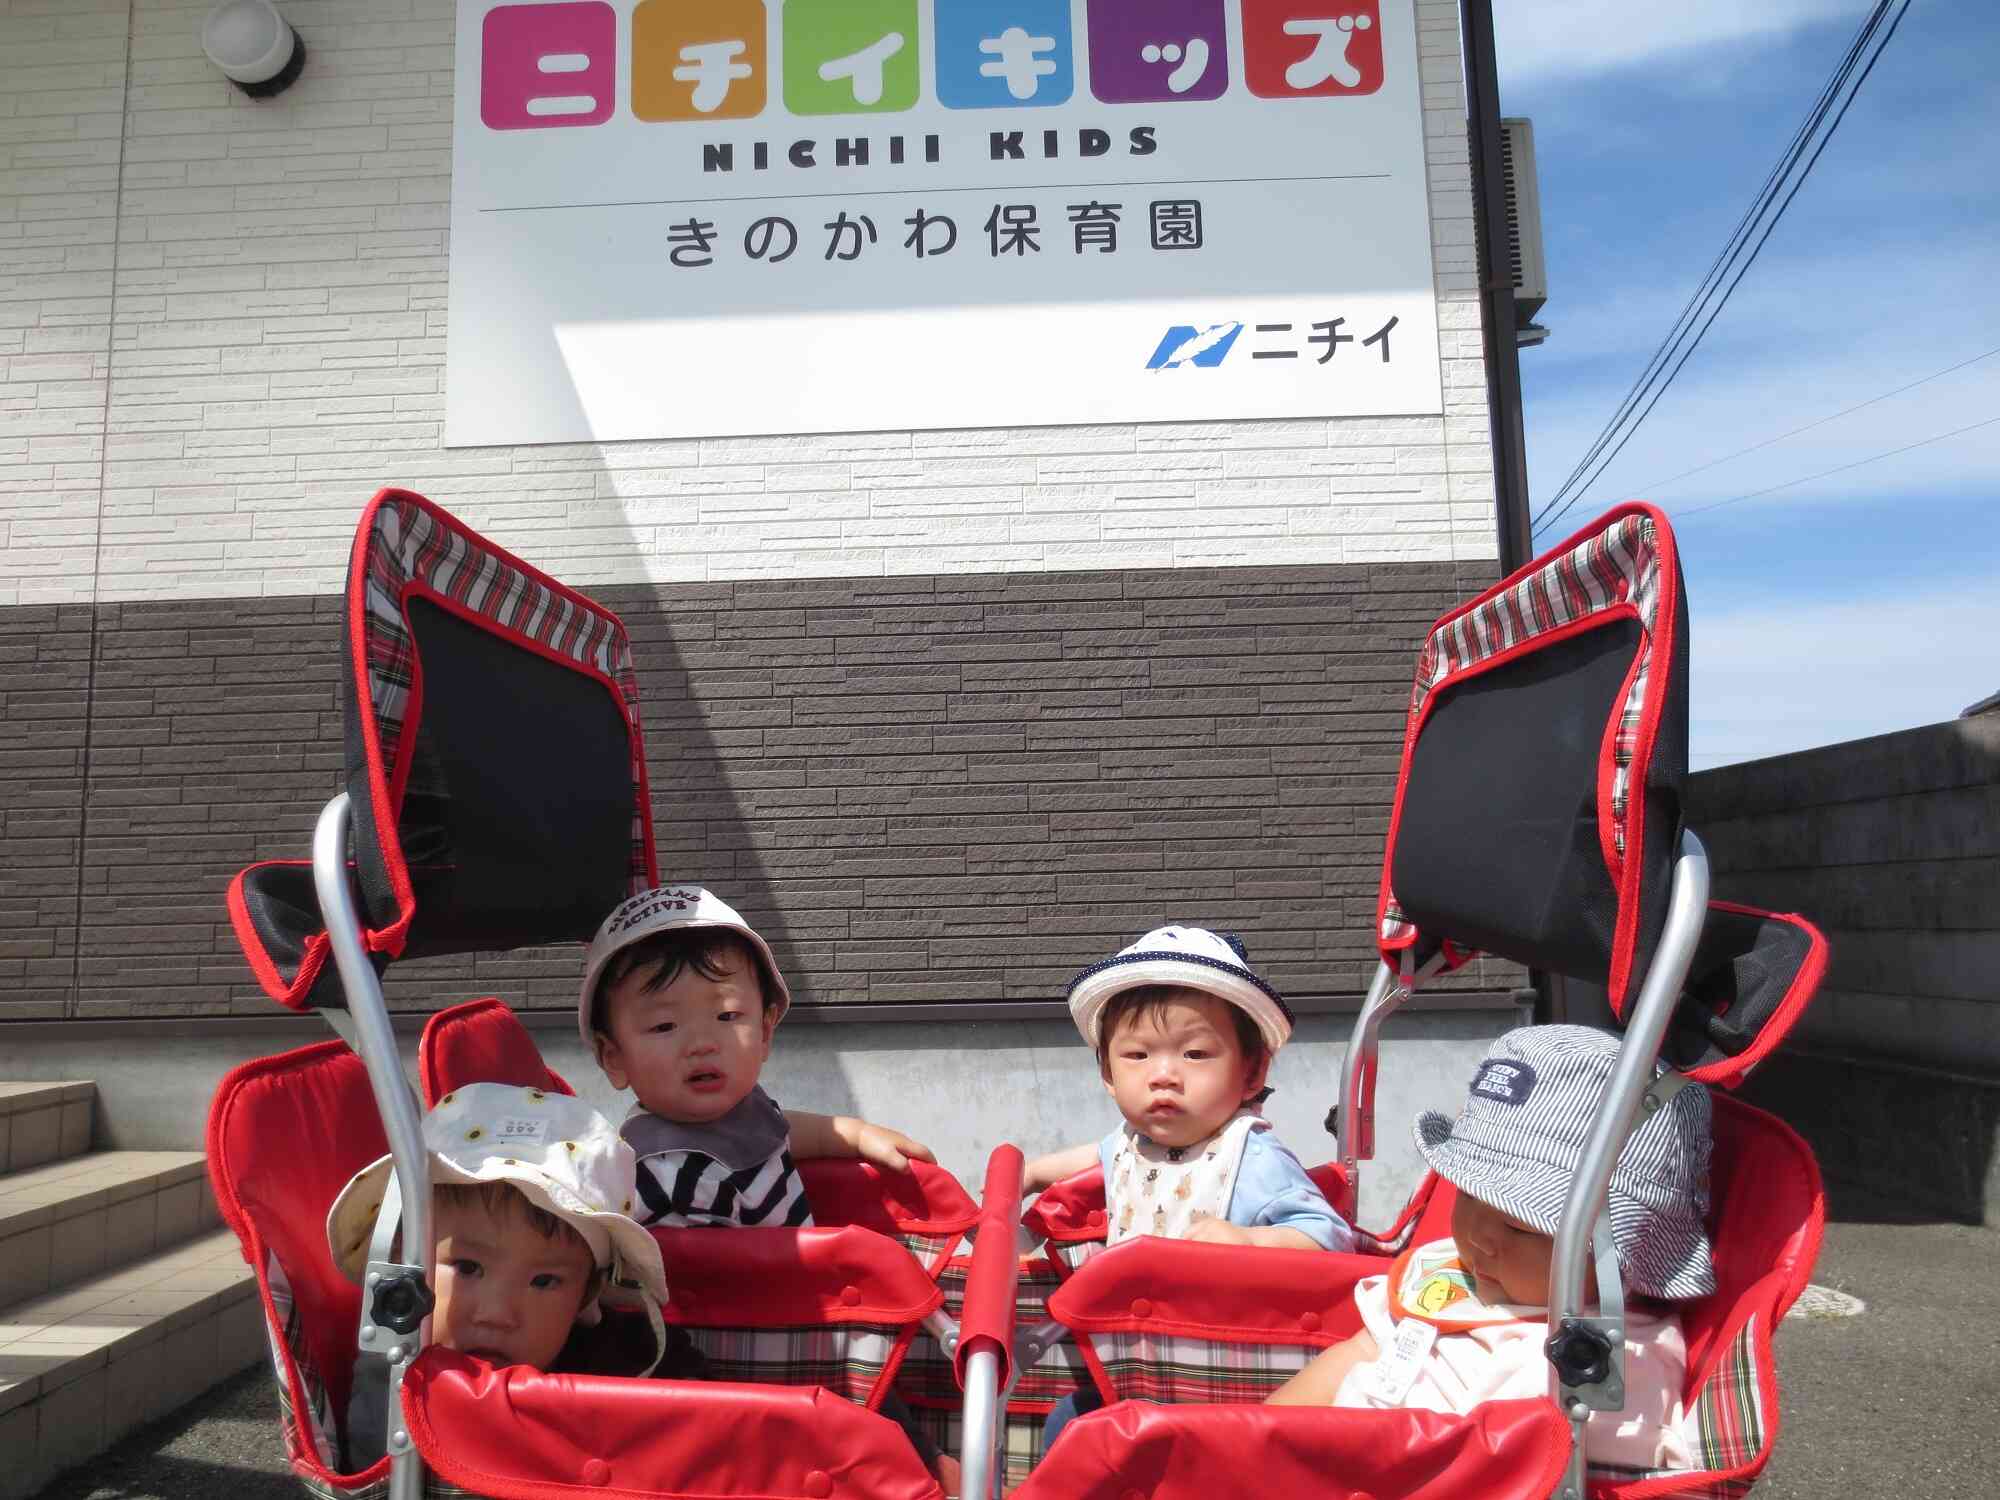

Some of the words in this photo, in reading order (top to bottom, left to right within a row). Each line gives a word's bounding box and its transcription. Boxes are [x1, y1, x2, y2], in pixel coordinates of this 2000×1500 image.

[526, 14, 1372, 117] ニチイキッズ
[703, 135, 940, 172] NICHII
[989, 126, 1157, 163] KIDS
[666, 199, 1203, 268] きのかわ保育園
[1252, 316, 1399, 364] ニチイ
[623, 900, 688, 931] ACTIVE
